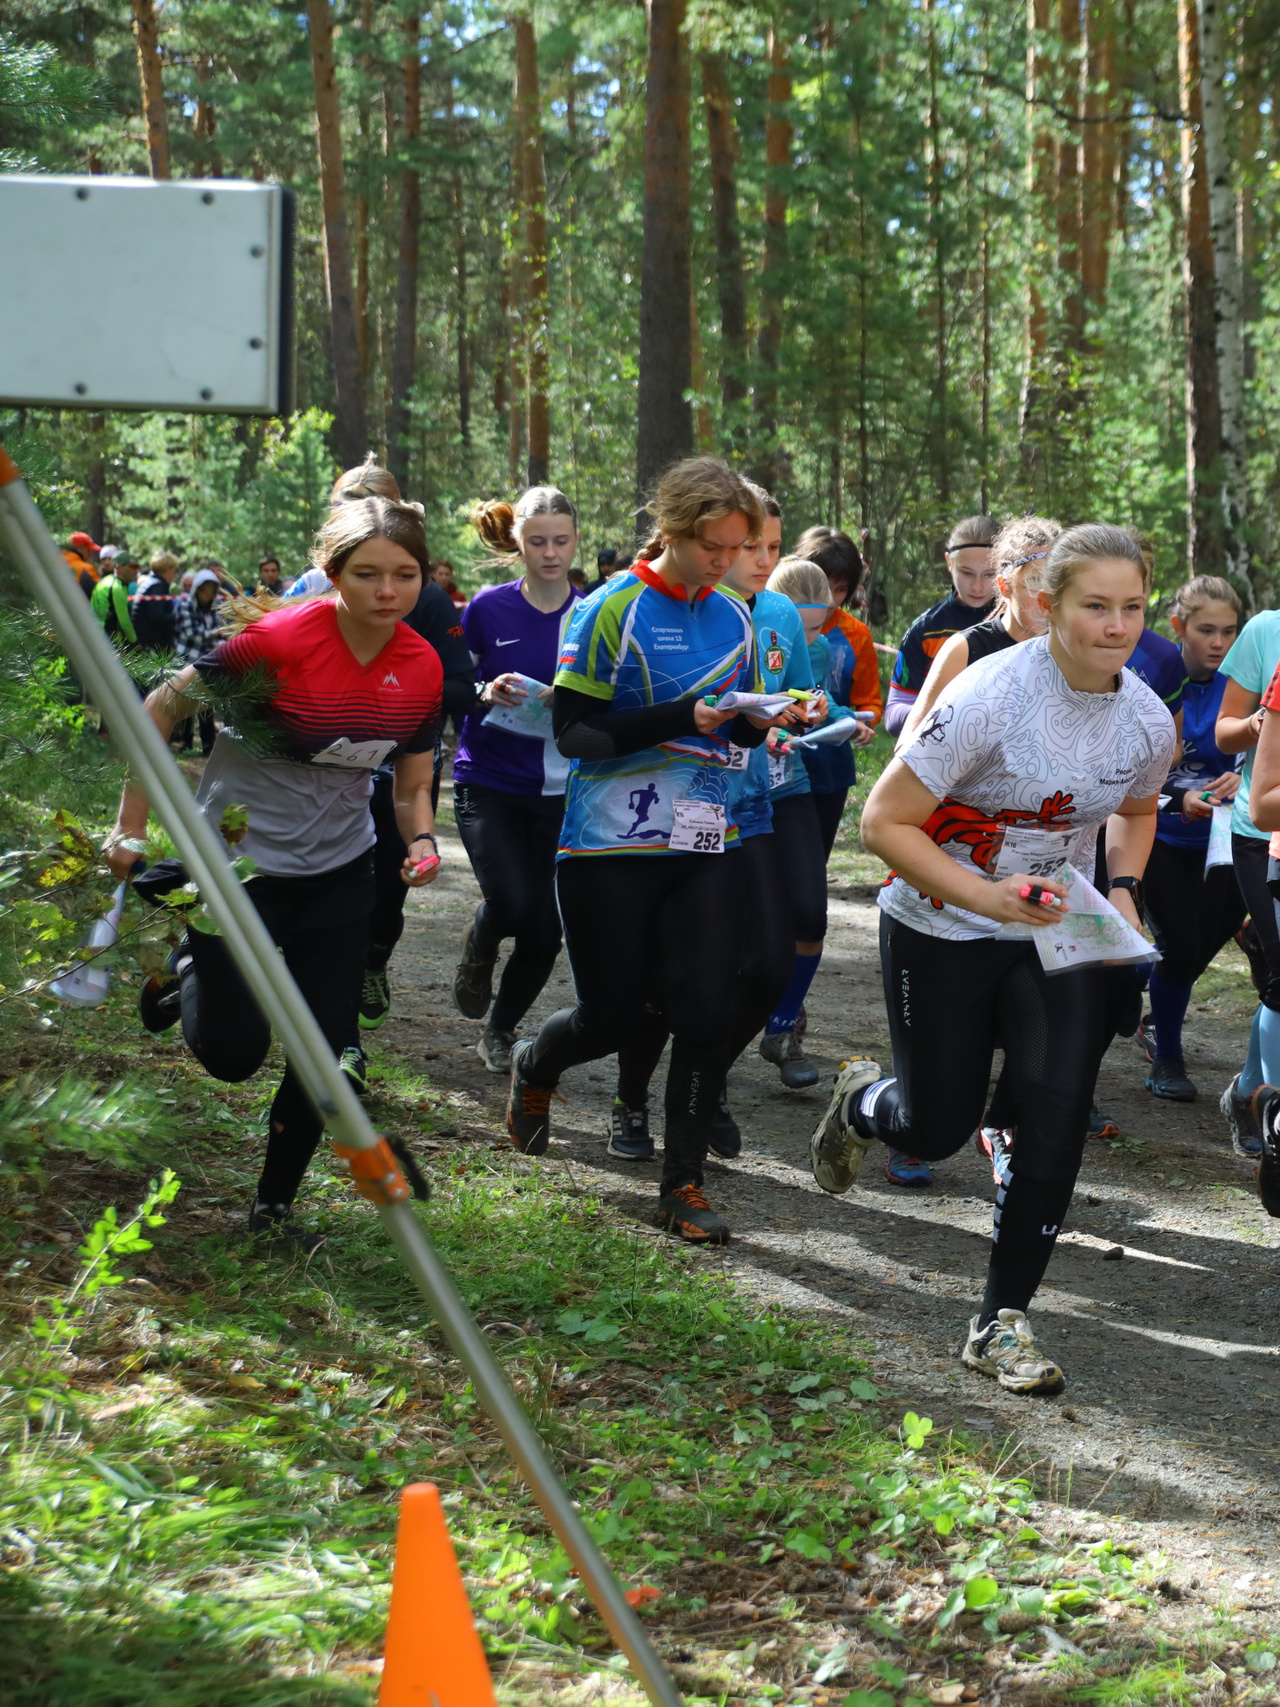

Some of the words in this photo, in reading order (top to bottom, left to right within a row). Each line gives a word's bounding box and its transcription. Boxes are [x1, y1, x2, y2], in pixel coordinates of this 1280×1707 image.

[327, 743, 379, 762] 261
[693, 831, 721, 851] 252
[901, 969, 912, 1027] ARSWEAR
